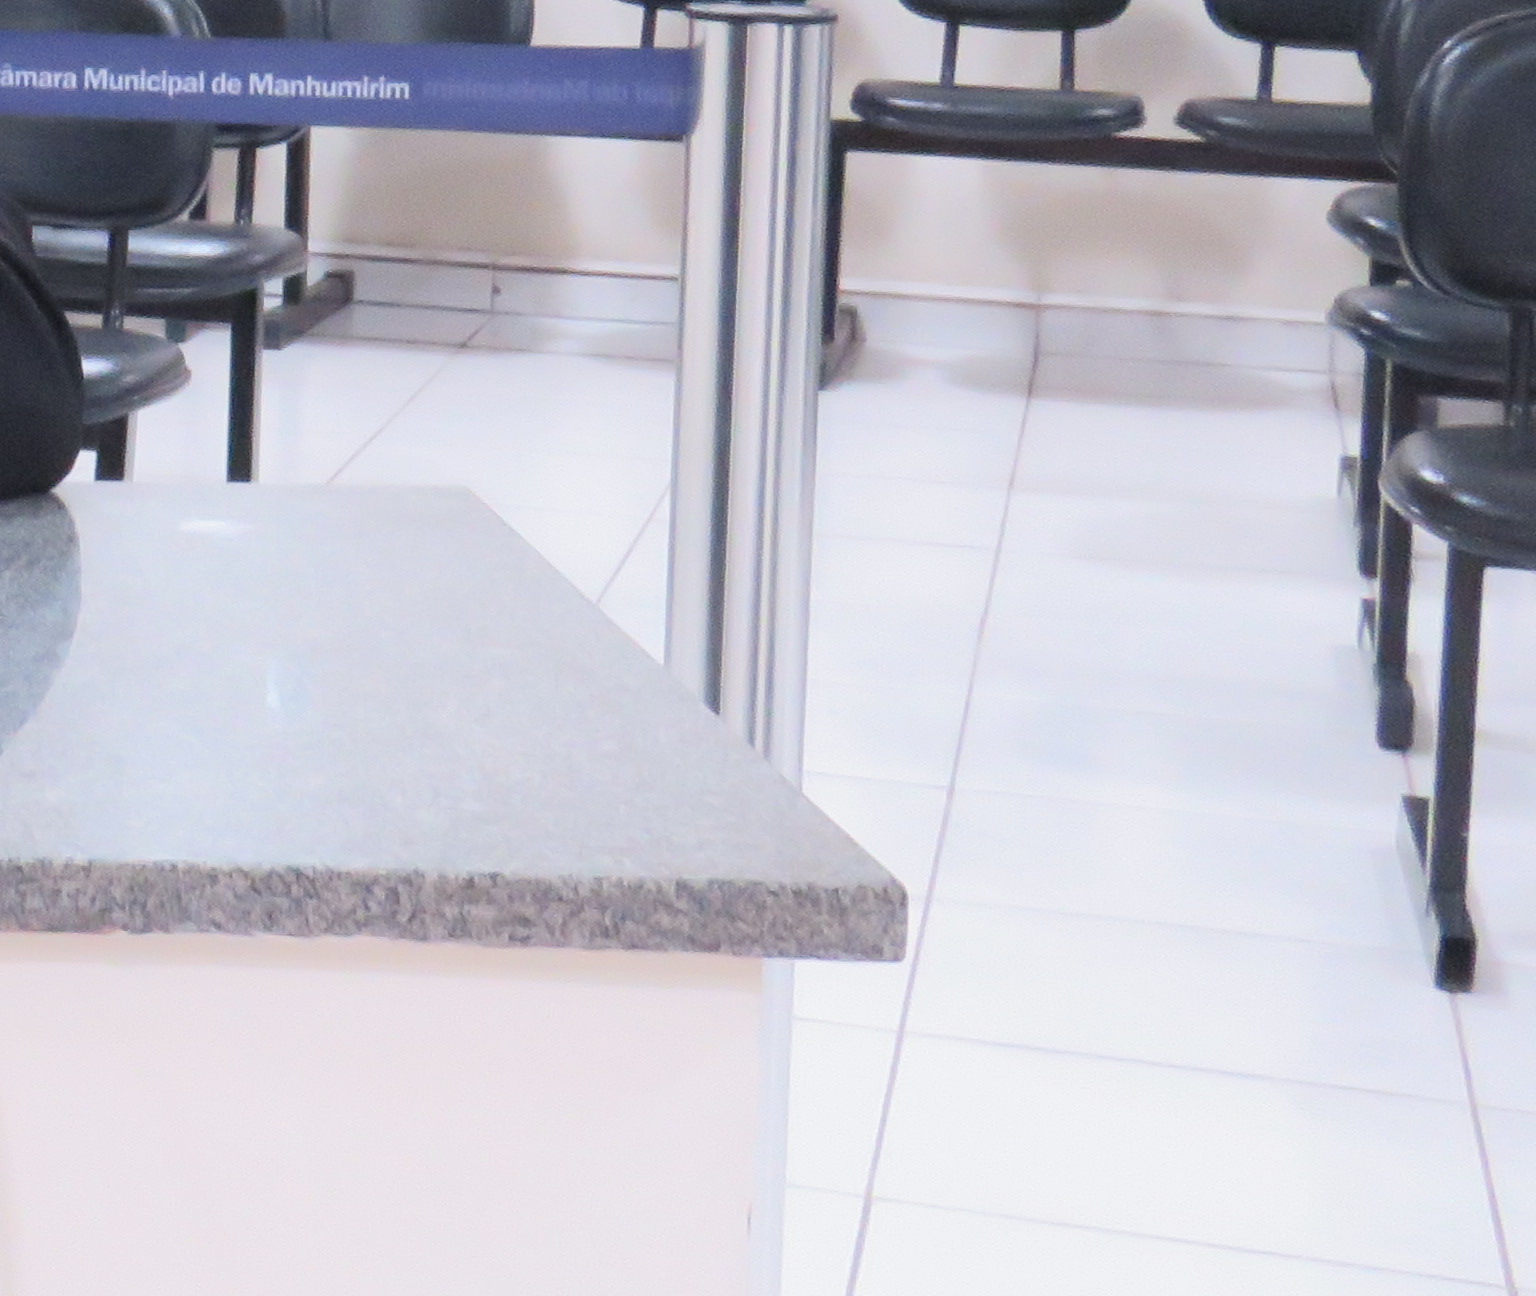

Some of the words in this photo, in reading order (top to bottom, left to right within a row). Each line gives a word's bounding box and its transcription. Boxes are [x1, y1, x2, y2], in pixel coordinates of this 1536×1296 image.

[82, 65, 206, 98] Municipal
[211, 72, 241, 96] de
[247, 74, 410, 101] Manhumirim
